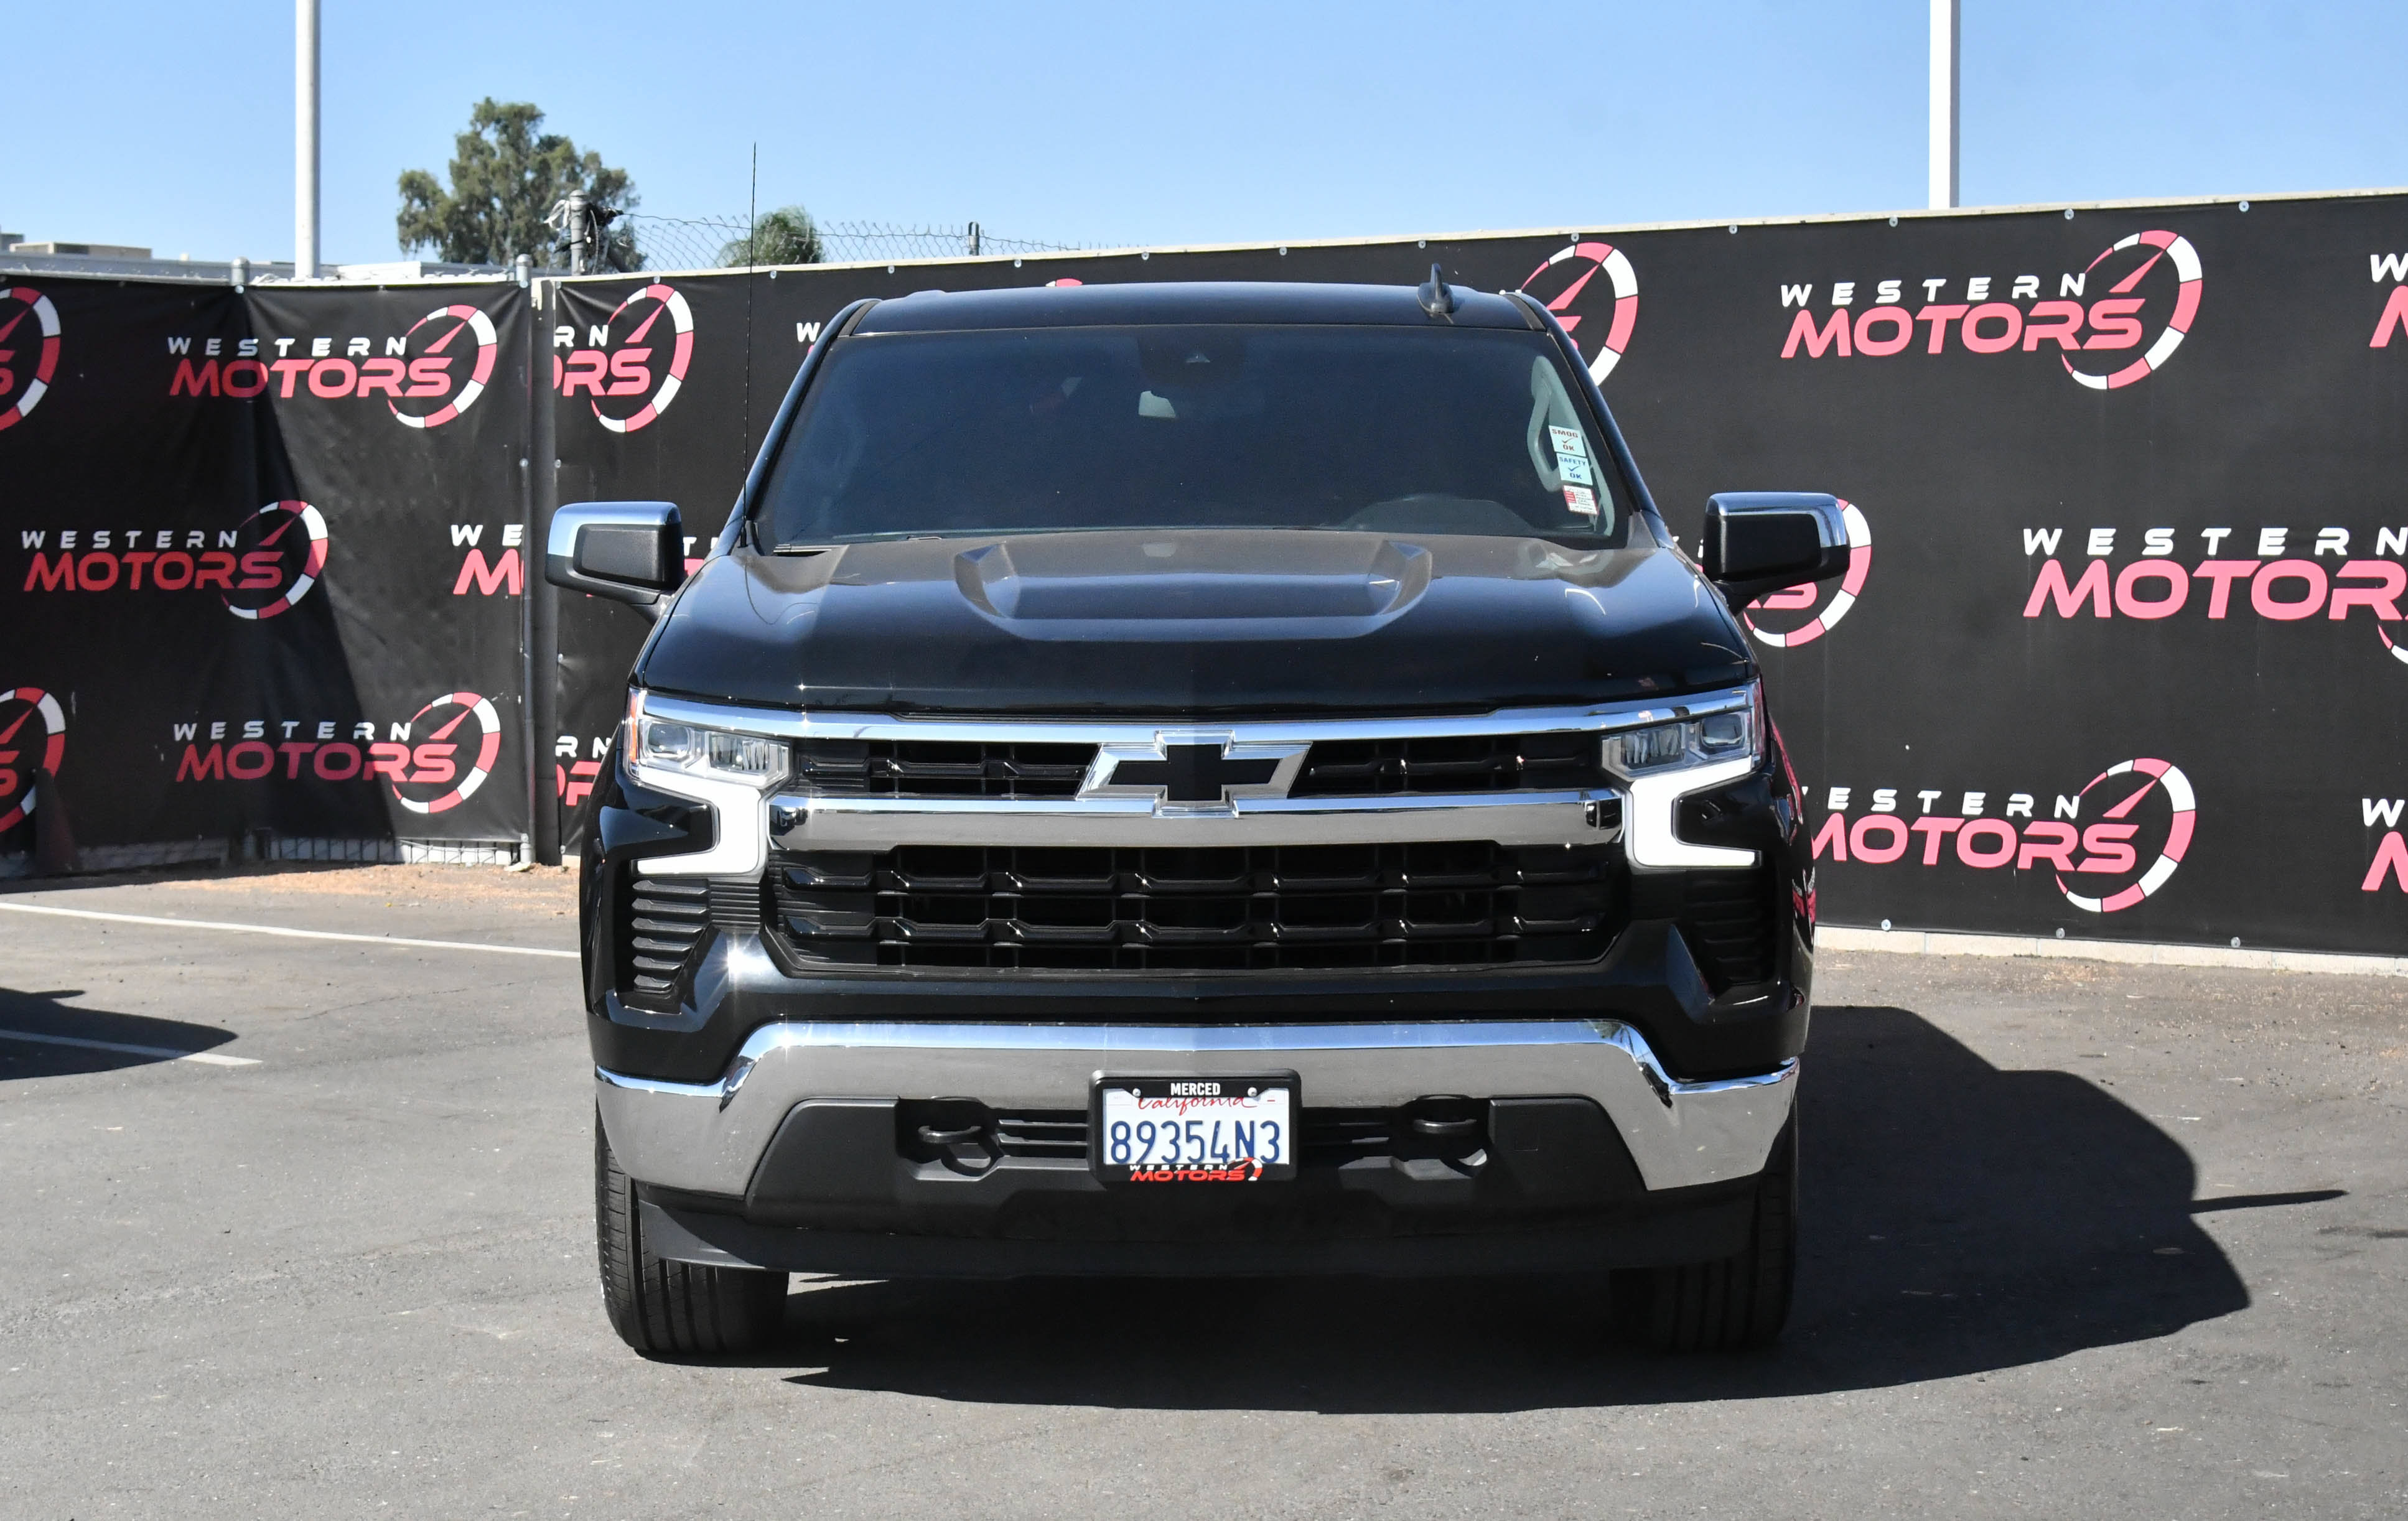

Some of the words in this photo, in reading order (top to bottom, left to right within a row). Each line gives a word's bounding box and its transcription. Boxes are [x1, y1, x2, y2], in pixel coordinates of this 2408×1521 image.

[1781, 273, 2086, 308] WESTERN
[1781, 299, 2145, 359] MOTORS
[169, 337, 407, 357] WESTERN
[169, 356, 453, 399] MOTORS
[1552, 429, 1578, 438] SMOG
[1559, 457, 1586, 465] SAFETY
[22, 530, 238, 549] WESTERN
[2023, 527, 2408, 557] WESTERN
[24, 551, 284, 592] MOTORS
[2023, 559, 2408, 621] MOTOR
[175, 721, 411, 742] WESTERN
[176, 742, 458, 784] MOTORS
[1801, 786, 2080, 819] ESTERN
[1170, 1082, 1221, 1096] MERCED
[1111, 1120, 1280, 1164] 89354N3
[1130, 1170, 1246, 1181] MOTORS
